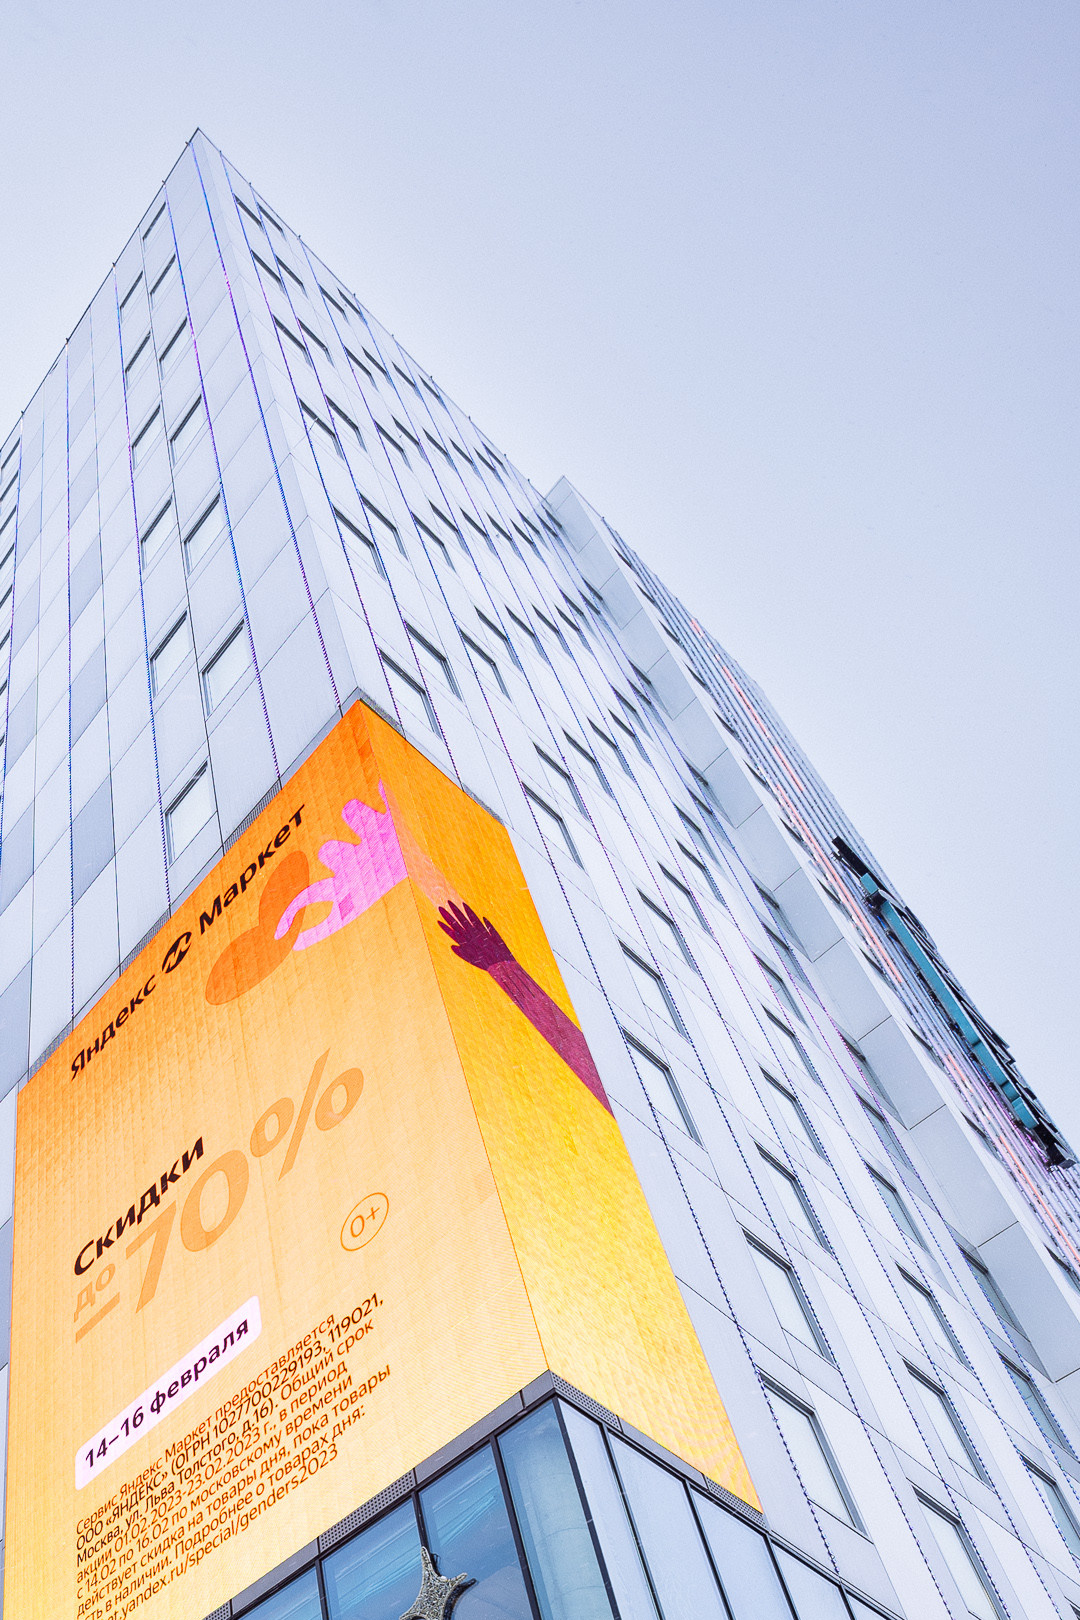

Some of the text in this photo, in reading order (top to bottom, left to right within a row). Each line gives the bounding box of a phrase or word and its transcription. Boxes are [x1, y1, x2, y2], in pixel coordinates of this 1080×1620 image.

[71, 804, 305, 1082] Яндекс Маркет
[73, 1263, 116, 1324] до
[74, 1136, 204, 1276] Скидки
[350, 1202, 380, 1238] 0+
[76, 1292, 384, 1550] ООО «ЯНДЕКС» (ОГРН 1027700229193, 119021,
[76, 1314, 335, 1535] Сервис Яндекс Маркет предоставляется
[76, 1526, 124, 1567] Москва,
[125, 1509, 143, 1531] ул.
[145, 1480, 175, 1514] Льва
[177, 1432, 239, 1484] Толстого,
[281, 1348, 334, 1401] Общий
[337, 1319, 374, 1356] срок
[76, 1546, 113, 1584] акции
[279, 1408, 288, 1423] в
[291, 1360, 348, 1413] период
[149, 1318, 249, 1415] февраля
[76, 1364, 391, 1619] действует скидка на товары дня, пока товары
[85, 1559, 117, 1594] 14.02
[119, 1548, 134, 1568] по
[136, 1517, 169, 1552] 16.02
[172, 1506, 188, 1526] по
[190, 1430, 282, 1511] московскому
[285, 1374, 353, 1436] времени
[105, 1598, 112, 1612] в
[115, 1552, 173, 1606] наличии.
[175, 1491, 253, 1559] Подробнее
[256, 1482, 265, 1496] о
[267, 1432, 329, 1486] товарах
[332, 1405, 366, 1442] дня:
